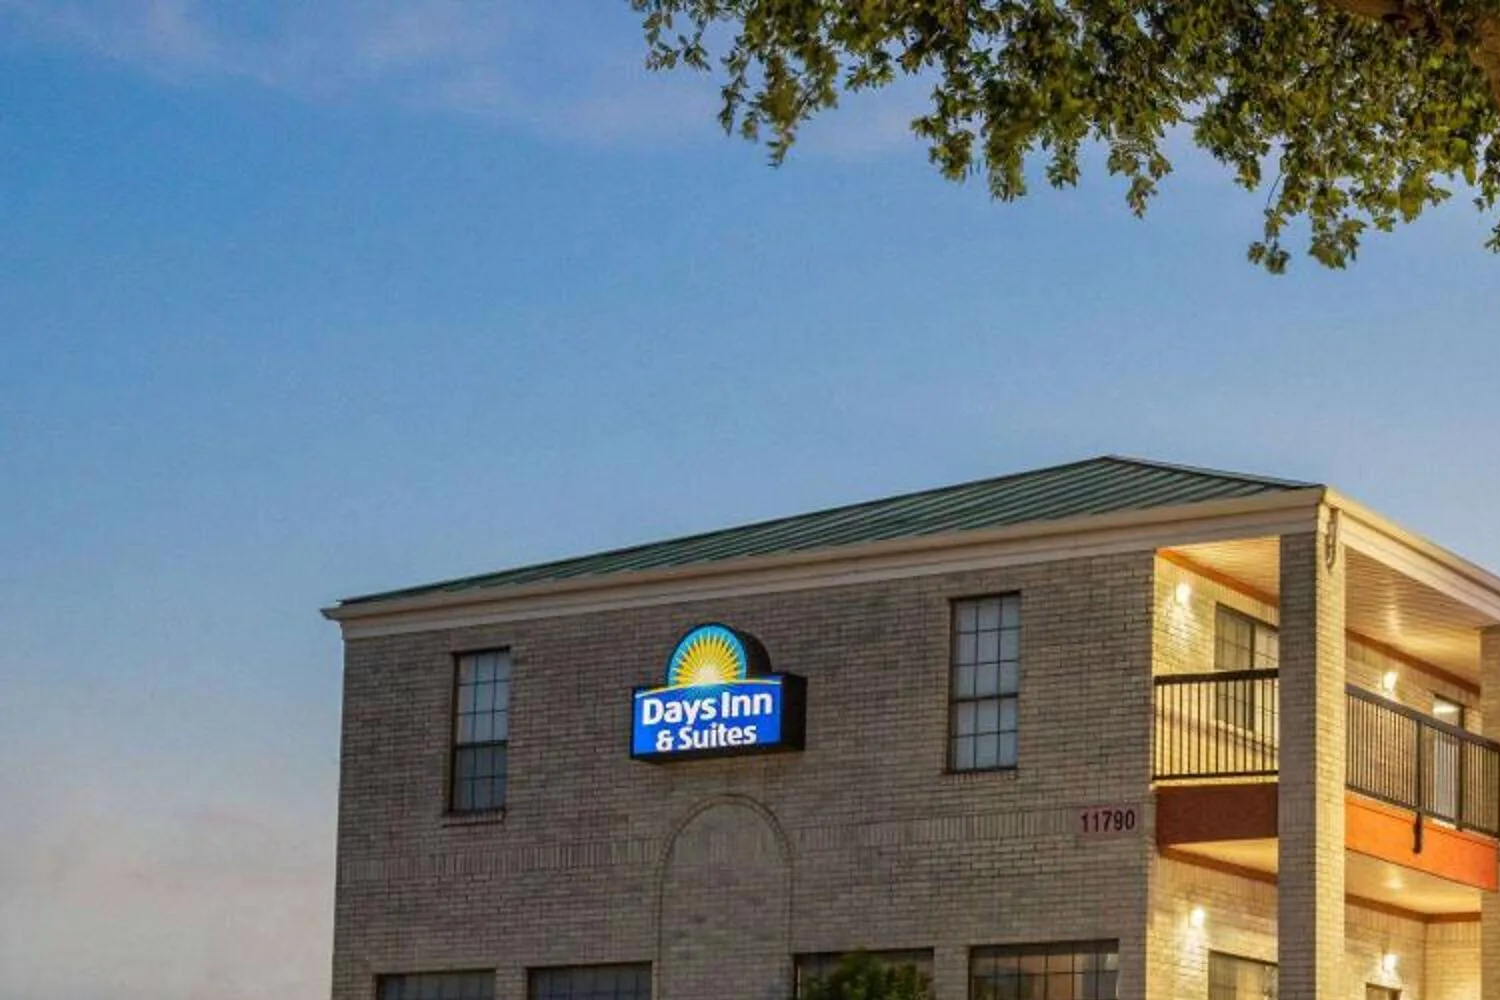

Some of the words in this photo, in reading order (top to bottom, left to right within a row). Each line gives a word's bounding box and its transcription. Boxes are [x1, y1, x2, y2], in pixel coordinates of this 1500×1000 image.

[642, 698, 716, 725] Days
[721, 692, 773, 718] Inn
[656, 730, 673, 751] &
[677, 722, 757, 750] Suites
[1081, 808, 1135, 833] 11790
